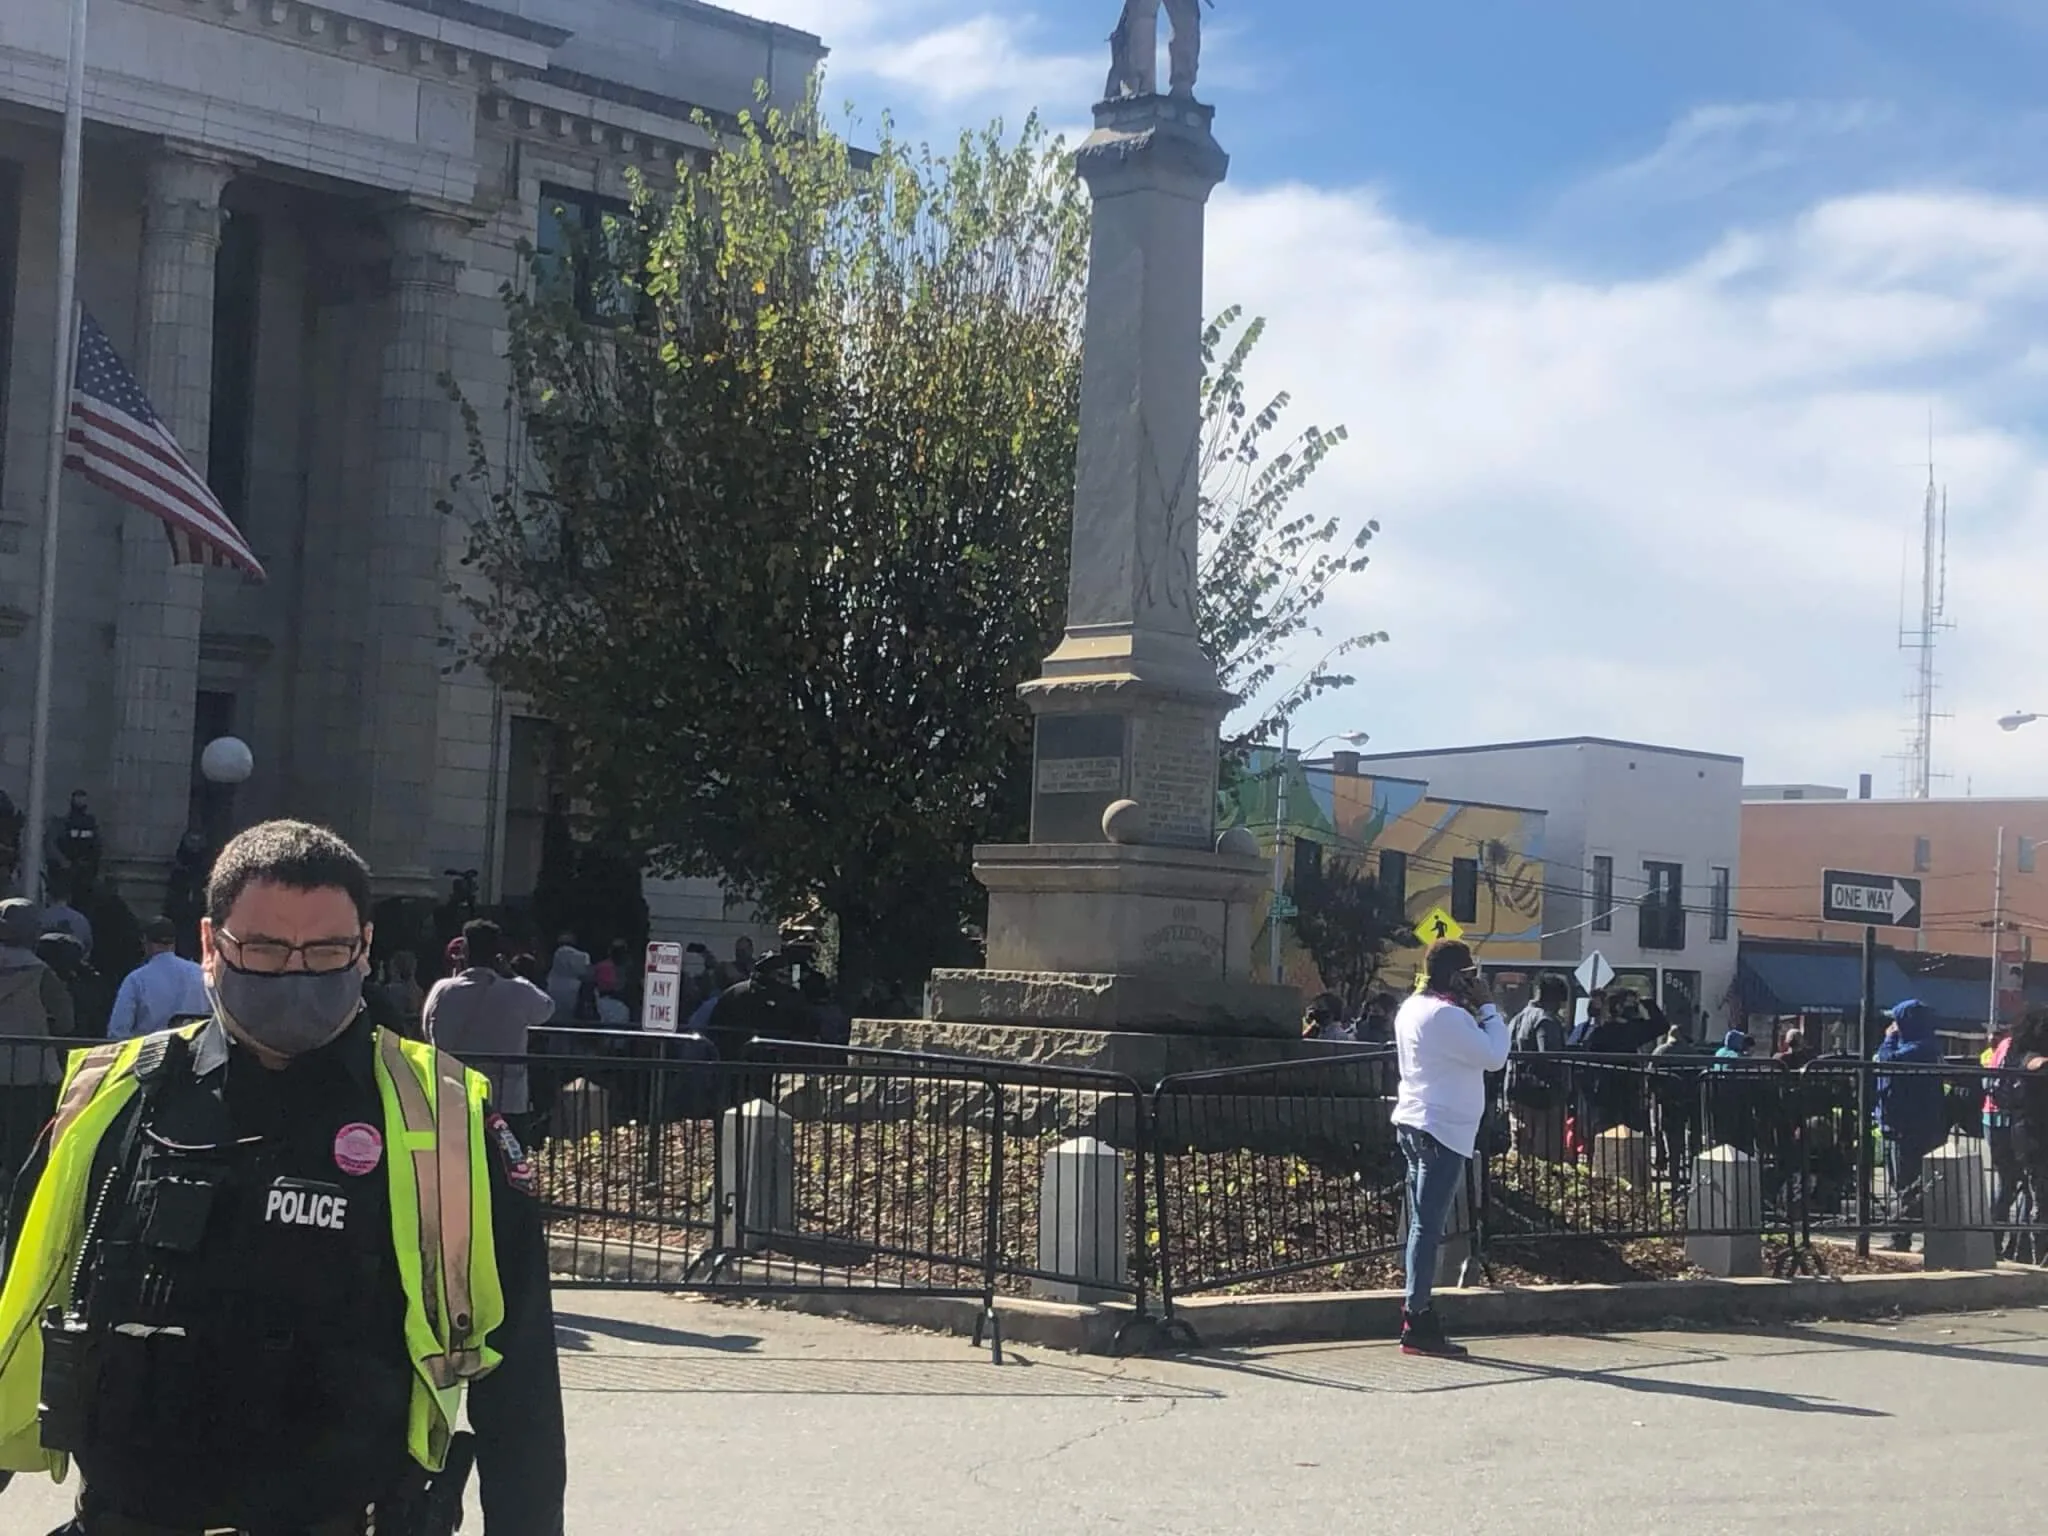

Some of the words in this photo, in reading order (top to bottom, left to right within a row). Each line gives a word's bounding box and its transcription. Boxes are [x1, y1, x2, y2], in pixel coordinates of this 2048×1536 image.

[1834, 886, 1862, 909] ONE
[1866, 889, 1894, 912] WAY
[651, 981, 672, 998] ANY
[649, 1004, 672, 1023] TIME
[265, 1190, 348, 1230] POLICE
